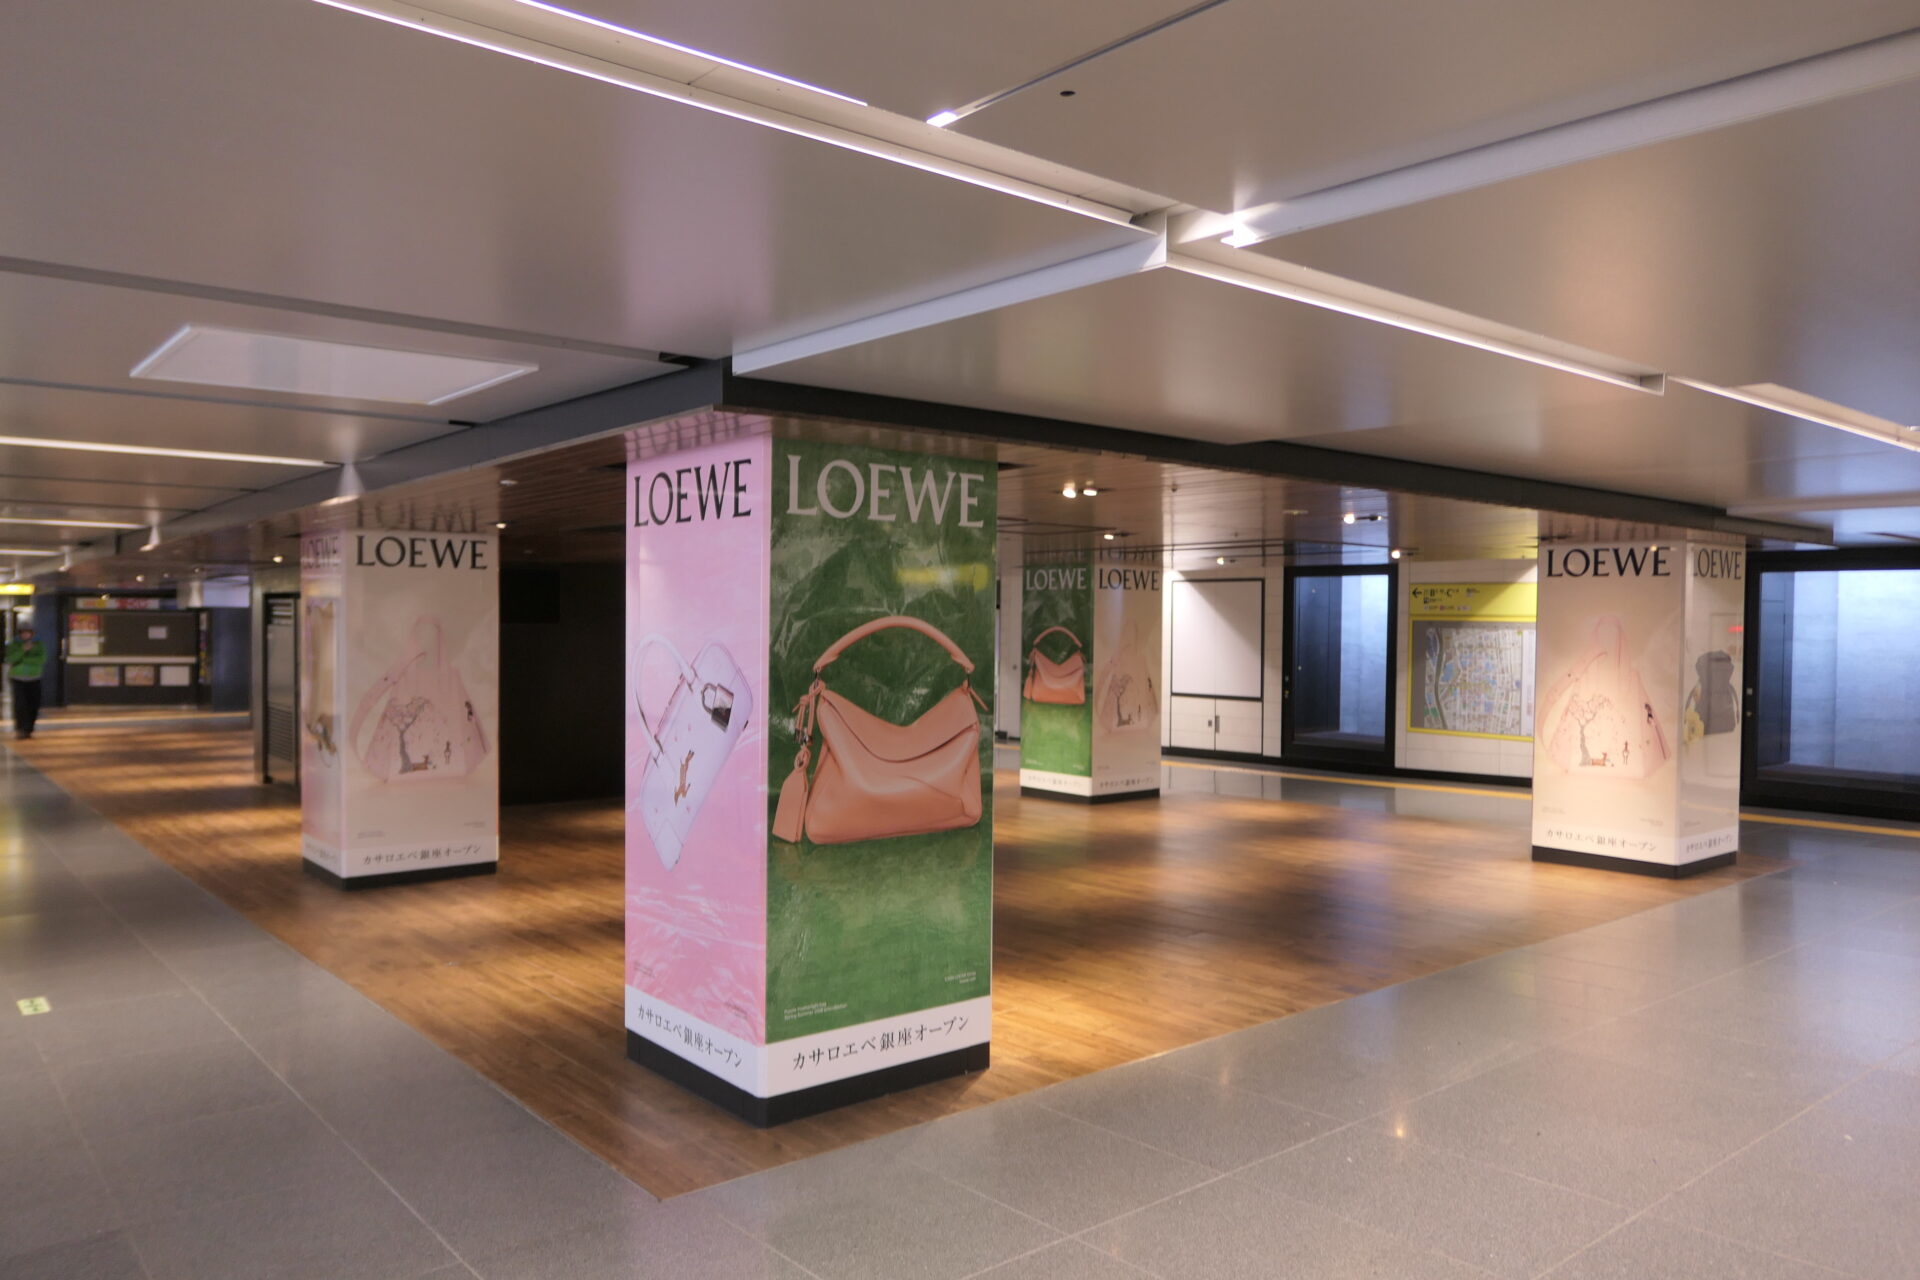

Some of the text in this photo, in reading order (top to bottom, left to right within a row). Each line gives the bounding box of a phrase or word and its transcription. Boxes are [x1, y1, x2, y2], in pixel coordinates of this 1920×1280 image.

[634, 458, 752, 528] LOEWE
[786, 454, 985, 528] LOEWE
[356, 535, 487, 570] LOEWE
[1547, 547, 1671, 577] LOEWE
[1026, 568, 1087, 591] LOEWE
[1099, 568, 1160, 591] LOEWE
[638, 1004, 742, 1068] カサロエベ銀座オープン
[793, 1015, 969, 1070] カサロエベ銀座オープン
